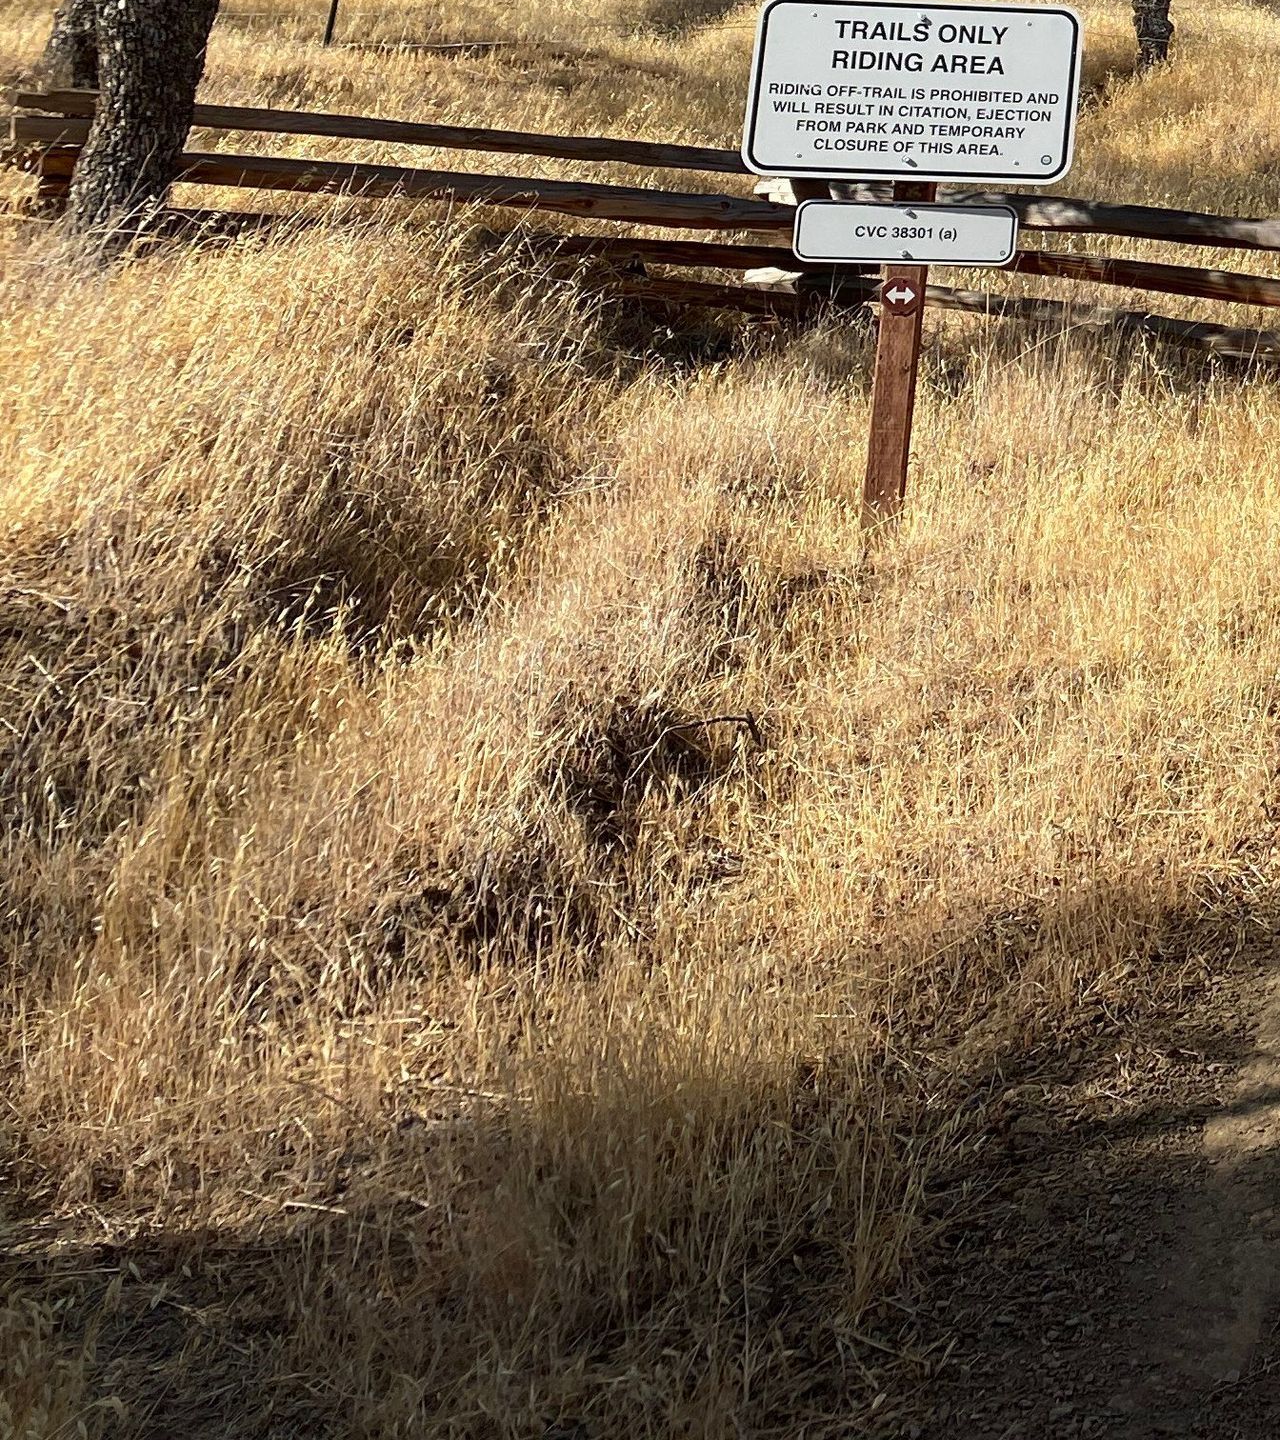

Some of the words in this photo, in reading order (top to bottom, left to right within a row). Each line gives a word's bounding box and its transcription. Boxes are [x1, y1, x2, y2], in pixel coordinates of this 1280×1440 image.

[834, 20, 929, 43] TRAILS
[938, 24, 1009, 45] ONLY
[831, 50, 923, 72] RIDING
[930, 54, 1005, 75] AREA
[768, 83, 822, 96] RIDING
[826, 85, 907, 100] OFF-TRAIL
[911, 88, 926, 100] IS
[930, 89, 1023, 104] PROHIBITED
[1026, 92, 1059, 105] AND
[773, 101, 810, 113] WILL
[814, 102, 875, 116] RESULT
[879, 105, 894, 116] IN
[898, 105, 972, 120] CITATION,
[976, 109, 1052, 122] EJECTION
[796, 120, 841, 133] FROM
[845, 122, 887, 134] PARK
[892, 123, 925, 136] AND
[929, 124, 1026, 139] TEMPORARY
[813, 138, 888, 152] CLOSURE
[893, 141, 914, 153] OF
[918, 142, 953, 155] THIS
[956, 144, 1004, 156] AREA.
[854, 225, 887, 238] CVC
[891, 226, 933, 240] 38301
[938, 228, 957, 242] (a)
